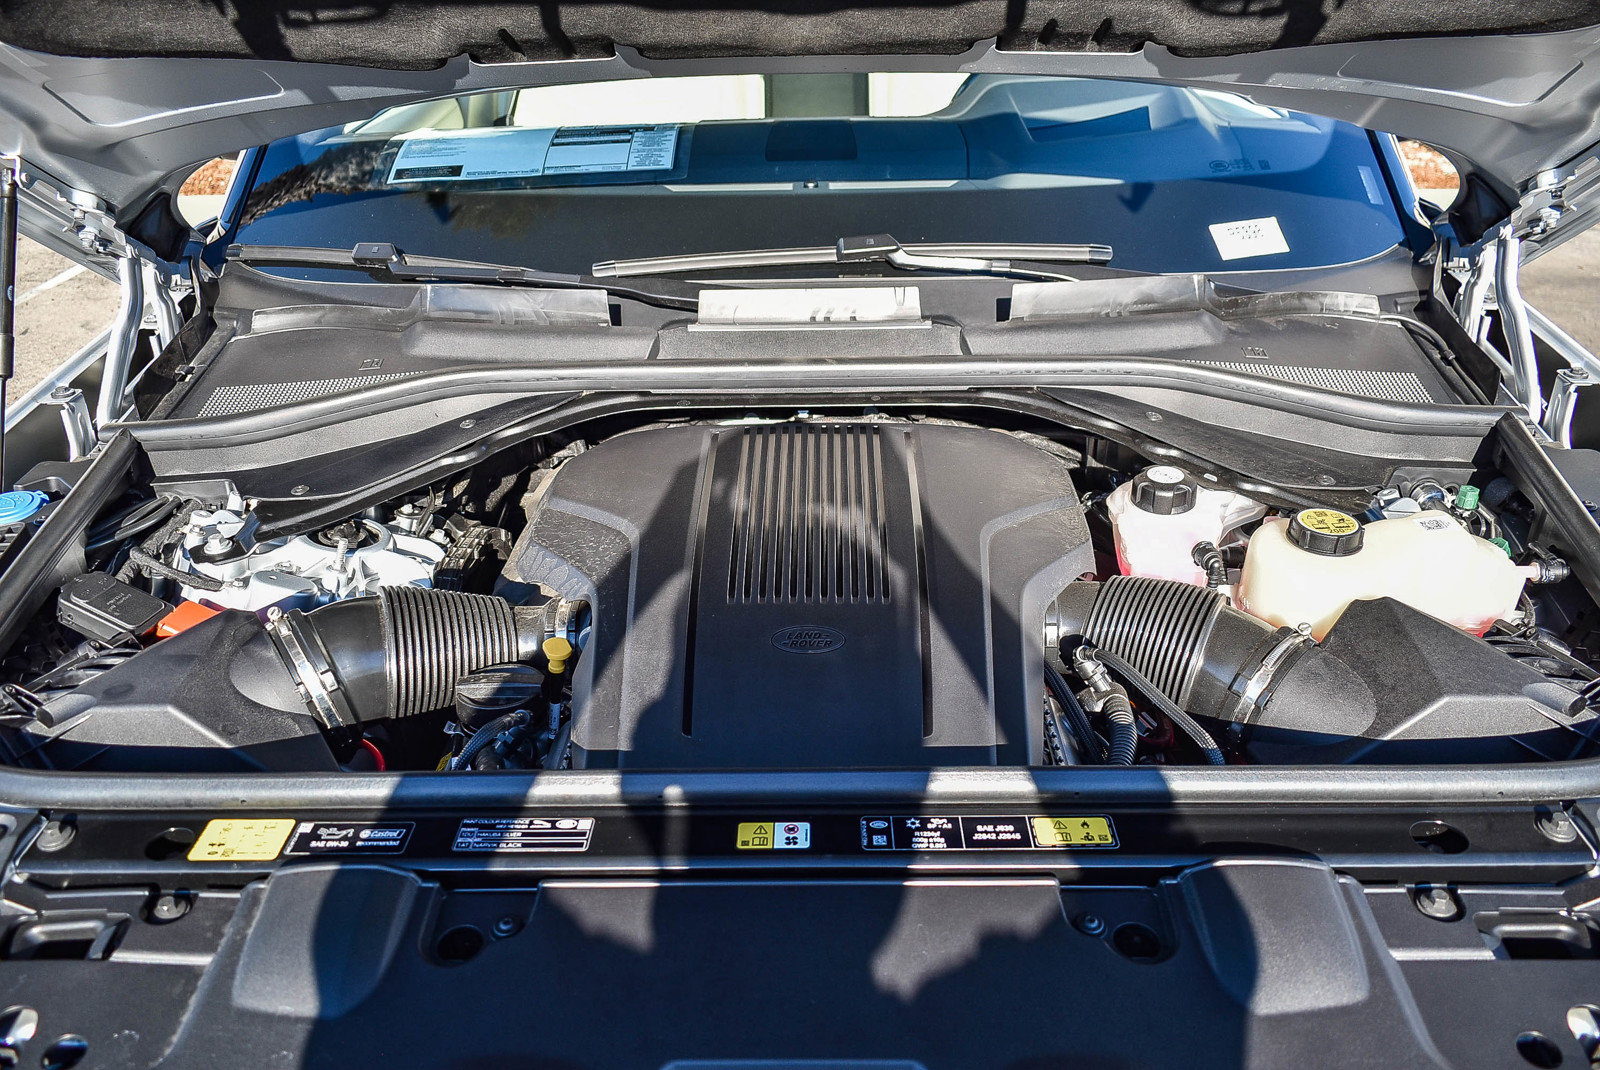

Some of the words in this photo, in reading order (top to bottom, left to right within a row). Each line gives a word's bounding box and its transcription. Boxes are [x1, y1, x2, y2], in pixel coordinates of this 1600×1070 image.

[786, 631, 821, 640] LAND
[789, 639, 833, 647] ROVER
[370, 830, 399, 838] Castrol
[310, 840, 326, 848] SAE
